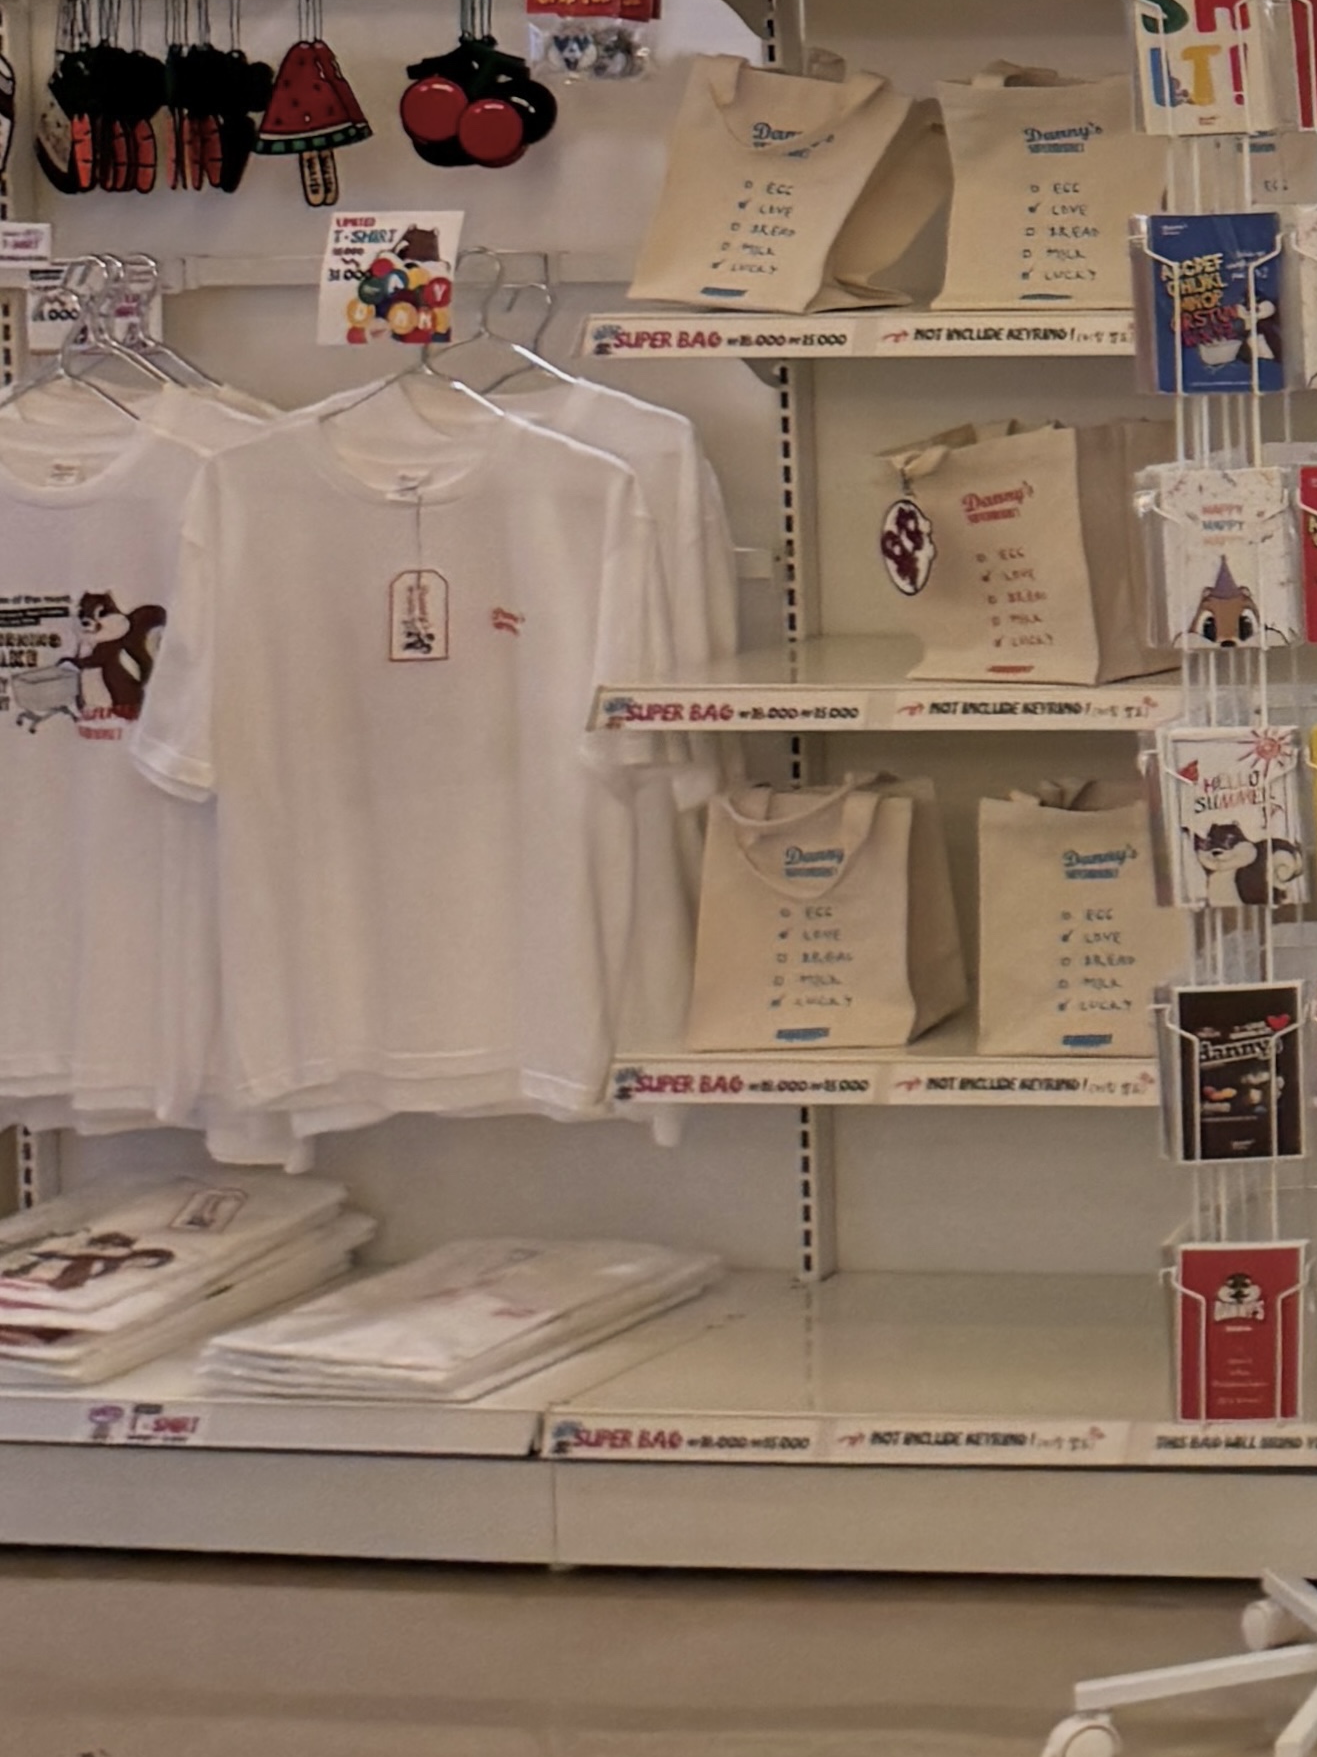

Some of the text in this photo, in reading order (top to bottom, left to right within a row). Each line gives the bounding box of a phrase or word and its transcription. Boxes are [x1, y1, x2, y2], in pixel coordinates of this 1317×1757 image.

[1148, 44, 1249, 108] IT!
[1024, 121, 1103, 143] Danny's
[614, 329, 723, 350] SUPER BAG
[914, 328, 942, 340] NOT
[963, 482, 1034, 513] Danny's
[626, 702, 733, 722] SUPER BAG
[1204, 771, 1260, 793] HELLO
[1063, 843, 1138, 868] Danny's
[635, 1073, 743, 1094] SUPER BAG
[573, 1428, 683, 1450] SUPER BAG
